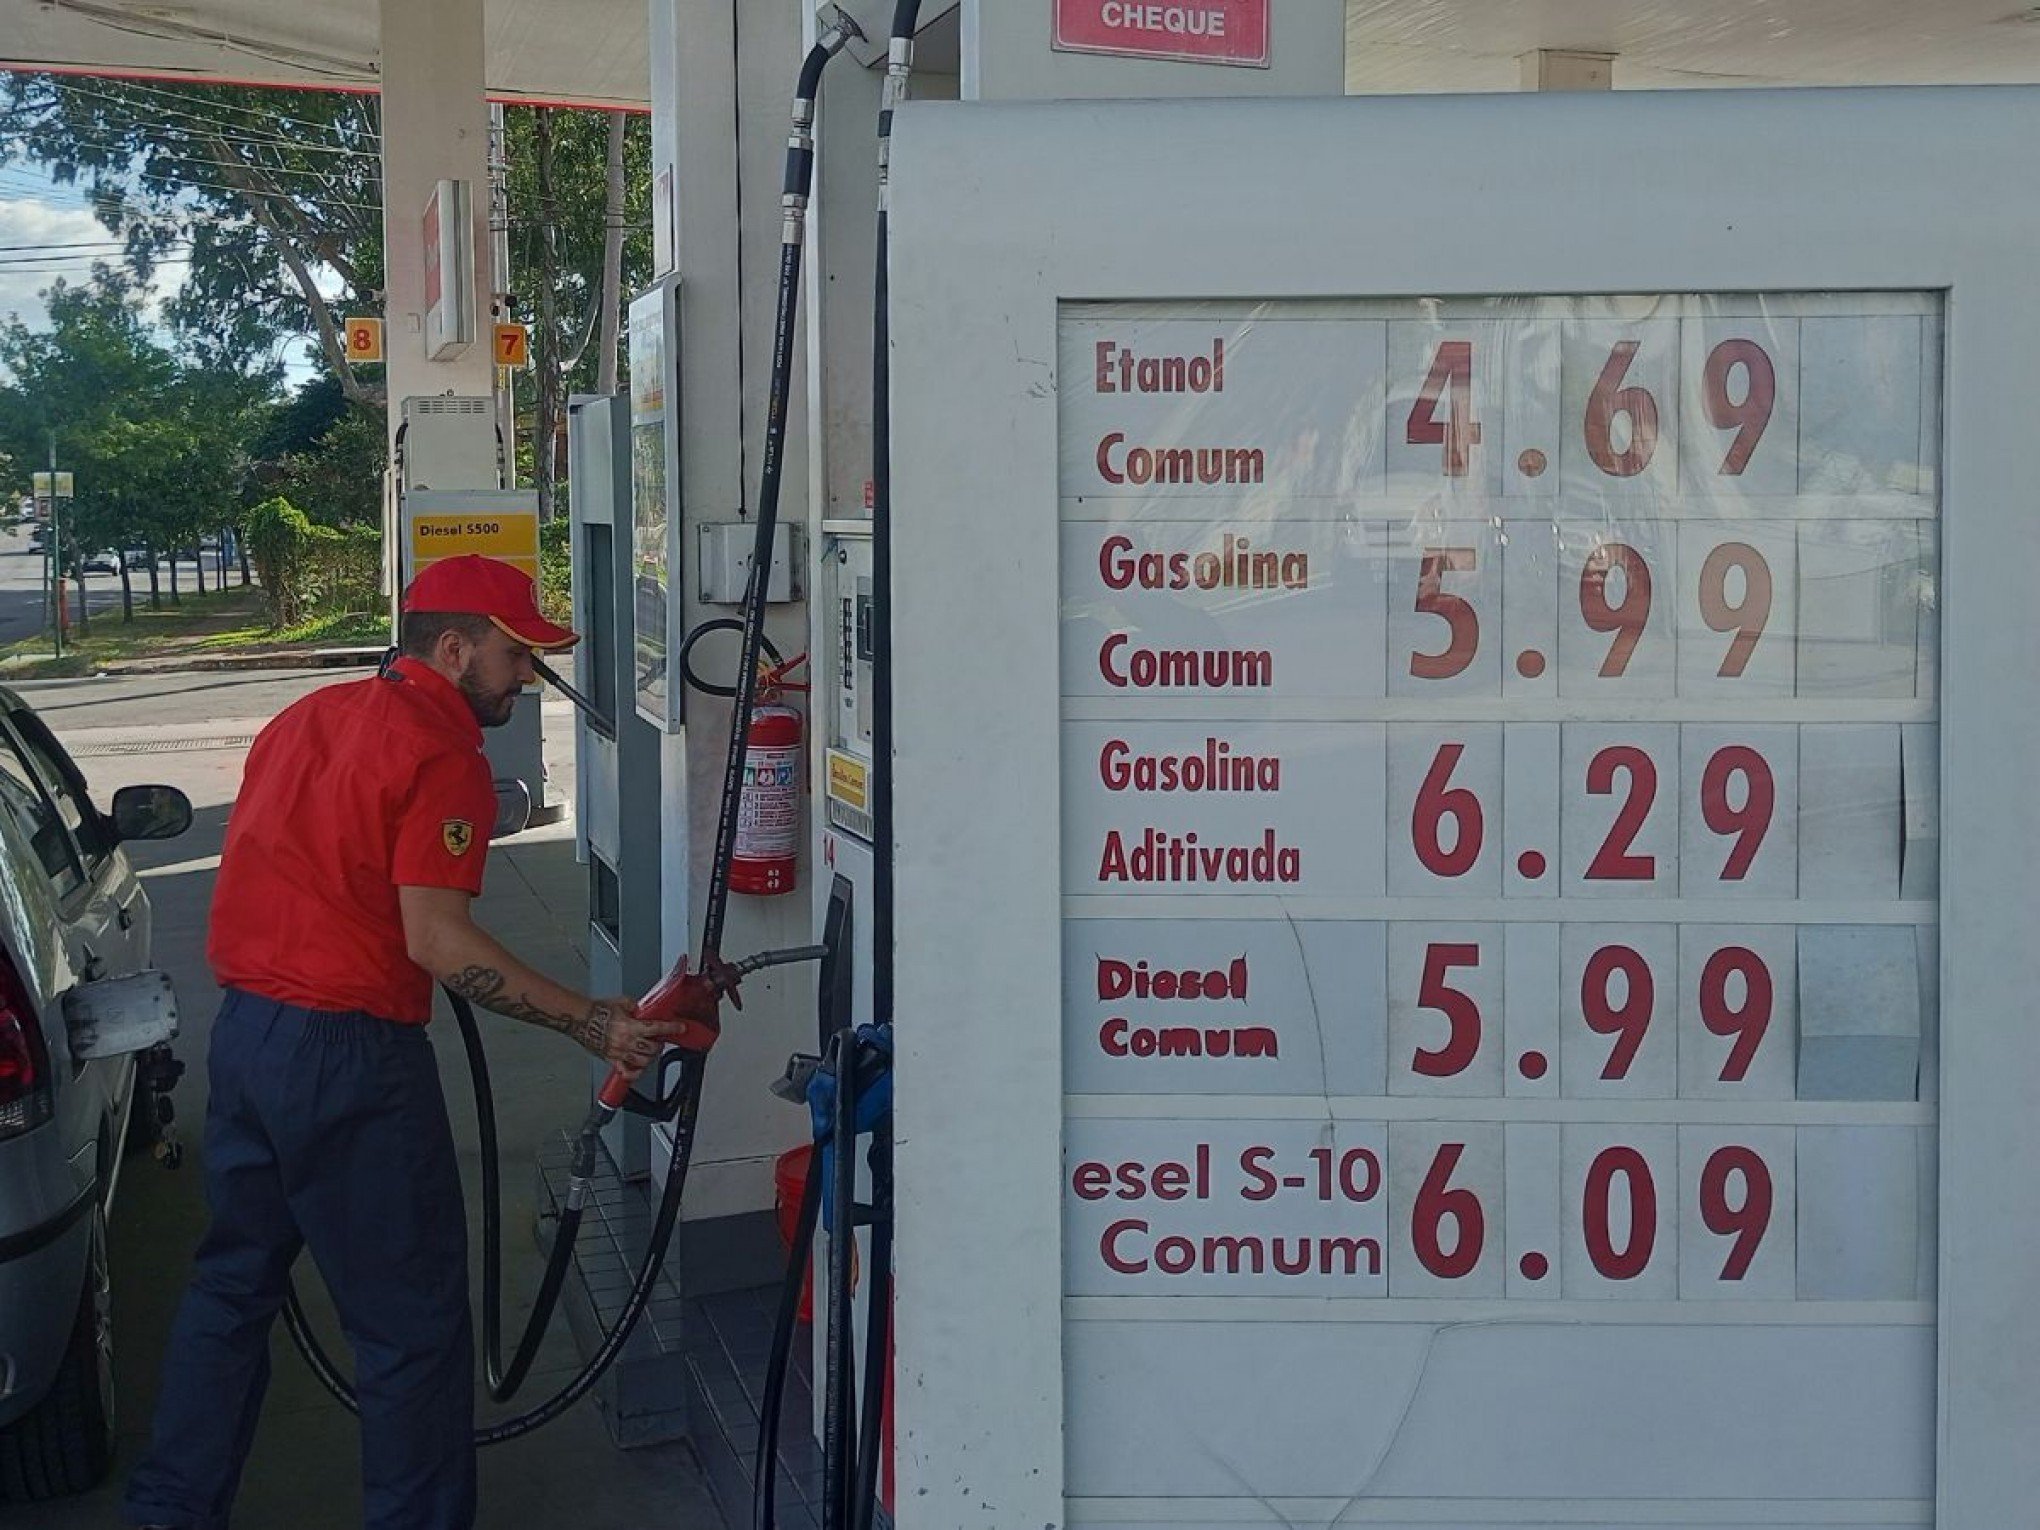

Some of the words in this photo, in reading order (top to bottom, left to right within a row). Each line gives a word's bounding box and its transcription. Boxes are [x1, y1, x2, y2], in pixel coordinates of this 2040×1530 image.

[1102, 2, 1225, 37] CHEQUE
[353, 329, 371, 351] 8
[500, 334, 519, 356] 7
[1096, 337, 1224, 393] Etanol
[1406, 338, 1776, 477] 4.69
[1096, 433, 1265, 484] Comum
[420, 524, 462, 537] Diesel
[466, 523, 500, 535] S500
[1099, 534, 1309, 591] Gasolina
[1410, 542, 1773, 680] 5.99
[1099, 633, 1273, 688] Comum
[1099, 738, 1280, 792] Gasolina
[1411, 744, 1776, 881] 6.29
[1098, 828, 1301, 883] Aditivada
[1097, 956, 1249, 1002] Diesel
[1411, 943, 1774, 1082] 5.99
[1099, 1018, 1279, 1058] Comum
[1239, 1145, 1382, 1202] S-10
[1411, 1143, 1774, 1280] 6.09
[1100, 1219, 1382, 1276] Comum
